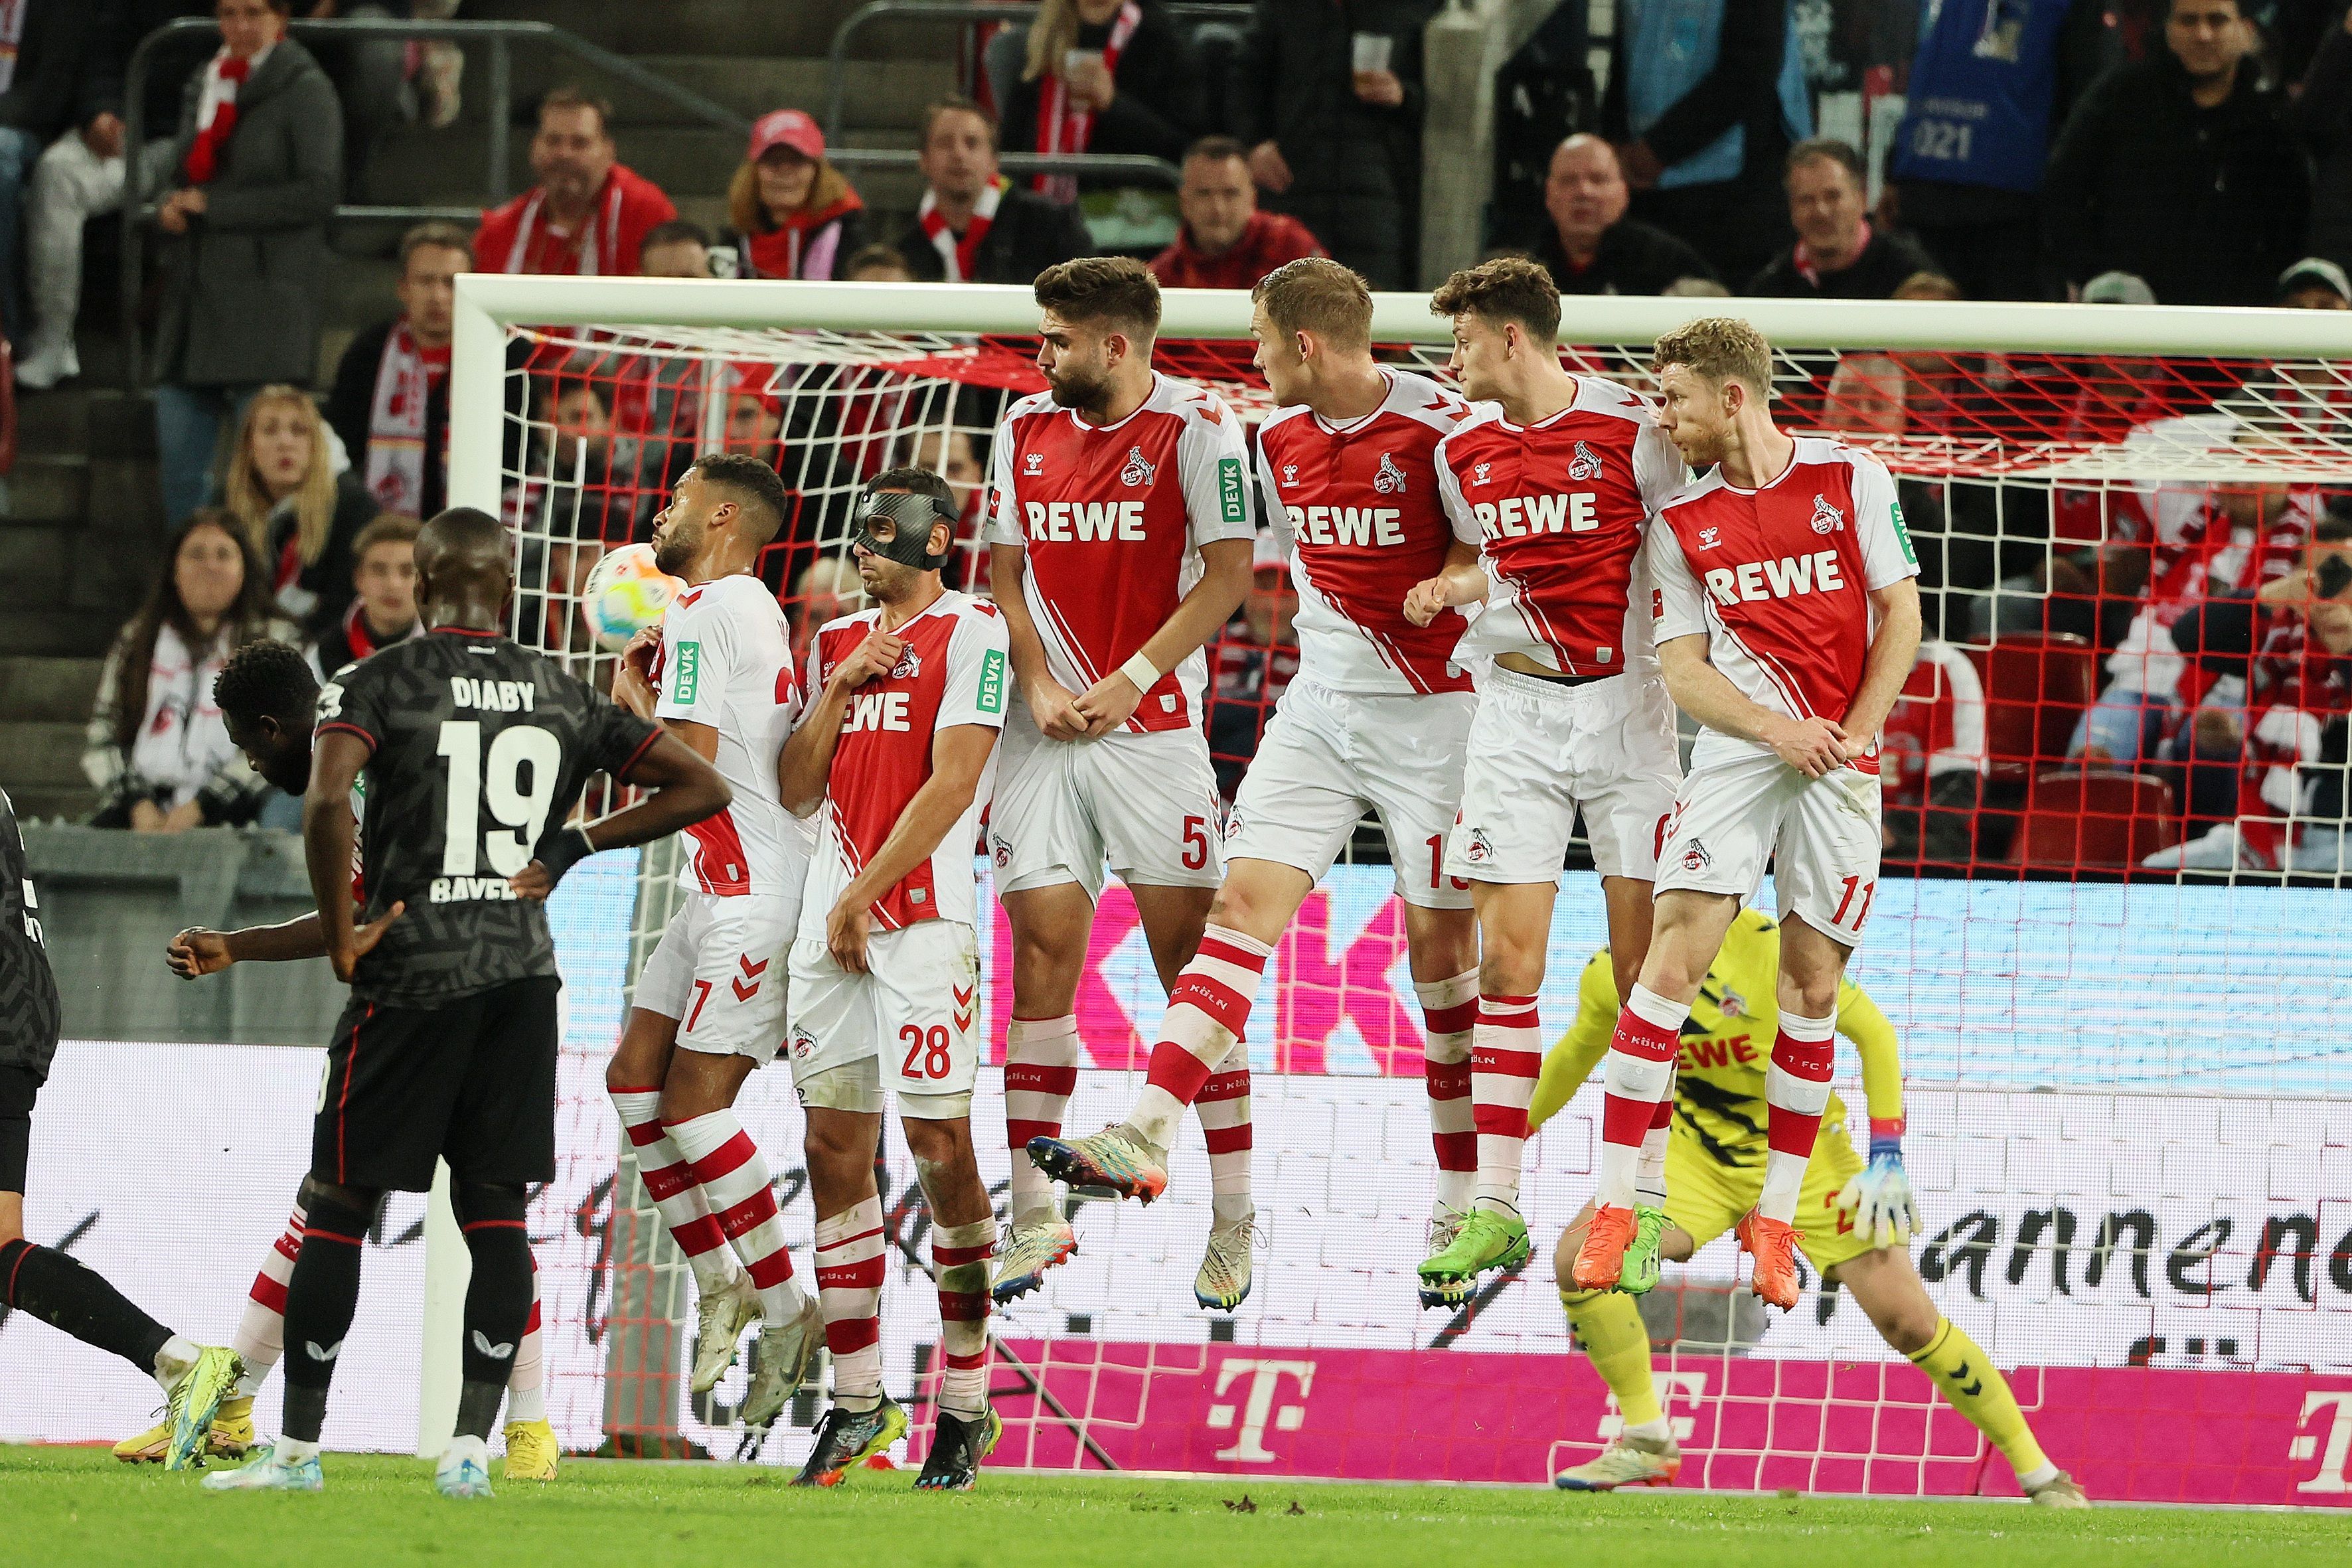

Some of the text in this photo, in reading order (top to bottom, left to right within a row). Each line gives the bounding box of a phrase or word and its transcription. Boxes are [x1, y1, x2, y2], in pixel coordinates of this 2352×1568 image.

[1224, 465, 1241, 516] DEVK
[1025, 501, 1146, 542] REWE
[1285, 506, 1405, 546] REWE
[1474, 493, 1599, 540] REWE
[1705, 550, 1843, 607] REWE
[450, 676, 534, 712] DIABY
[678, 647, 694, 700] DEVK
[982, 656, 1002, 708] DEVK
[840, 692, 911, 733] EWE
[436, 720, 562, 878] 19
[1182, 815, 1207, 870] 5
[1426, 834, 1469, 890] 1
[1831, 875, 1874, 932] 11
[1189, 984, 1228, 1011] KÖLN
[900, 1024, 951, 1079] 28
[1630, 1036, 1666, 1052] KÖLN
[1678, 1033, 1759, 1070] EWE
[1801, 1061, 1820, 1071] FC
[1919, 1207, 2352, 1304] annen
[1207, 1358, 1317, 1462] T
